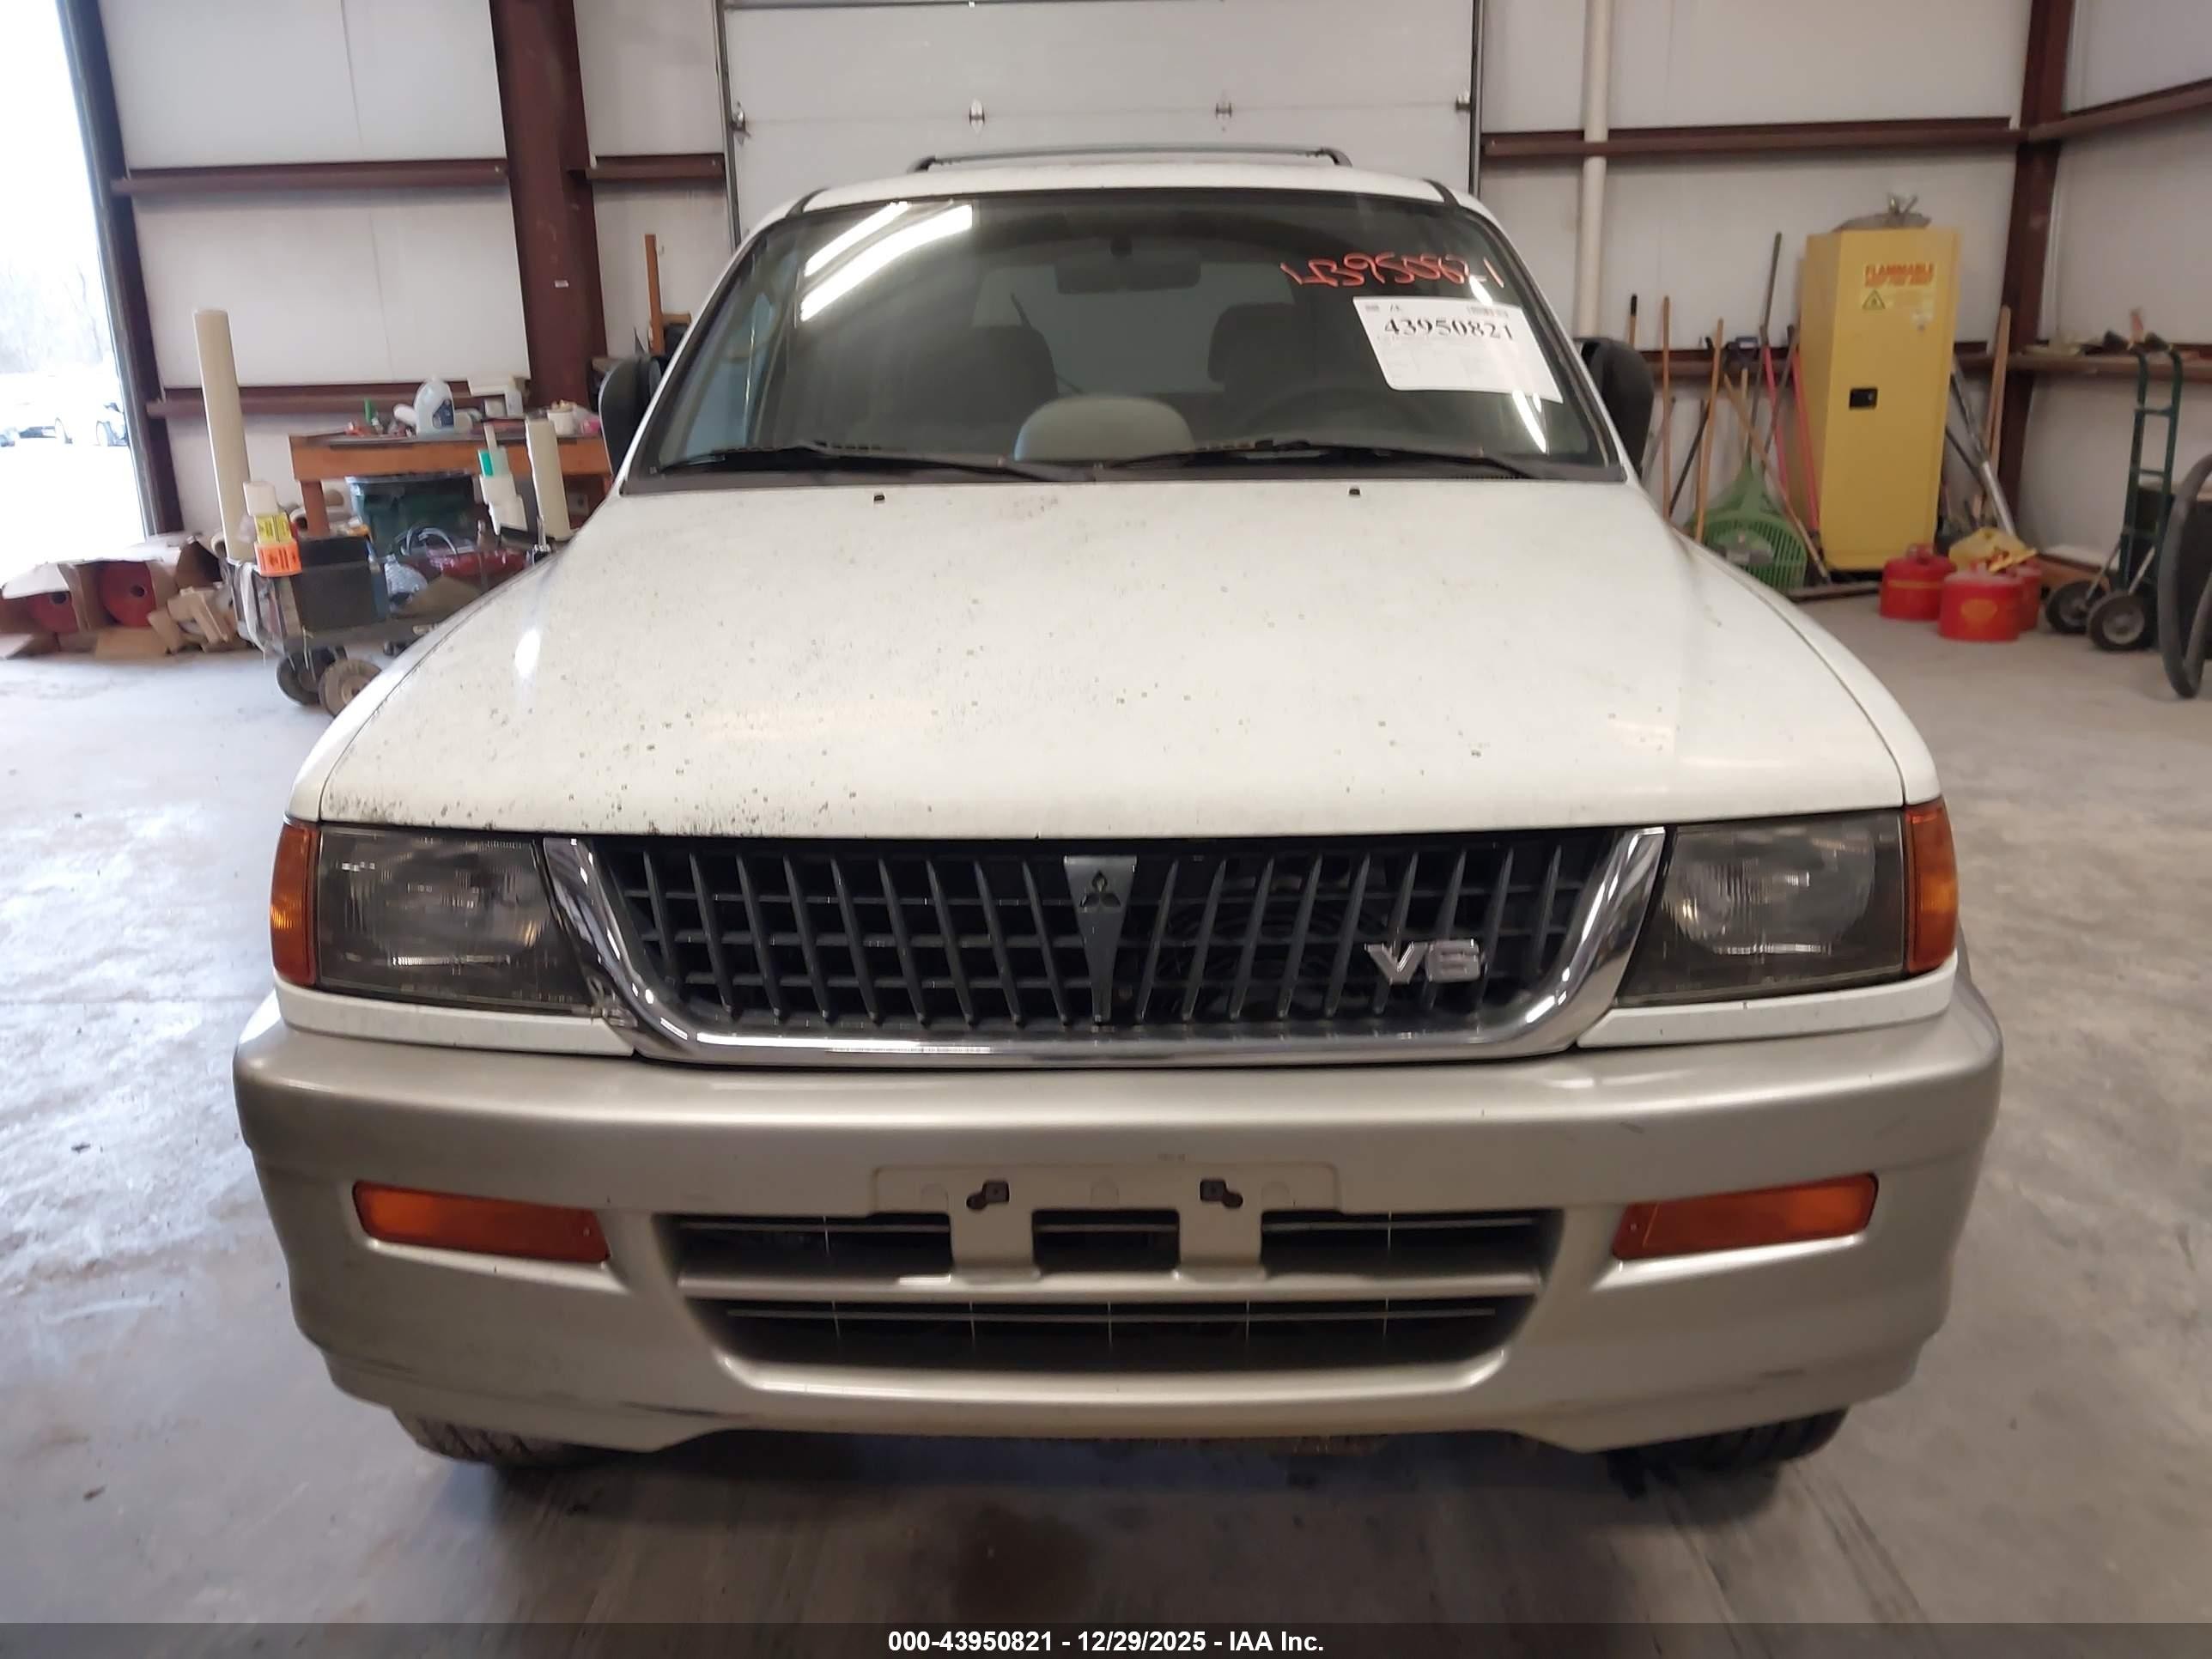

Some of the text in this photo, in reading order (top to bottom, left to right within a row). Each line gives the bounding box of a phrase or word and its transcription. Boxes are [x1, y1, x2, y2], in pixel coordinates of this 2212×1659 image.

[1865, 264, 1935, 276] FLAMMABLE
[1384, 319, 1514, 341] 43950821
[1364, 938, 1481, 985] V6
